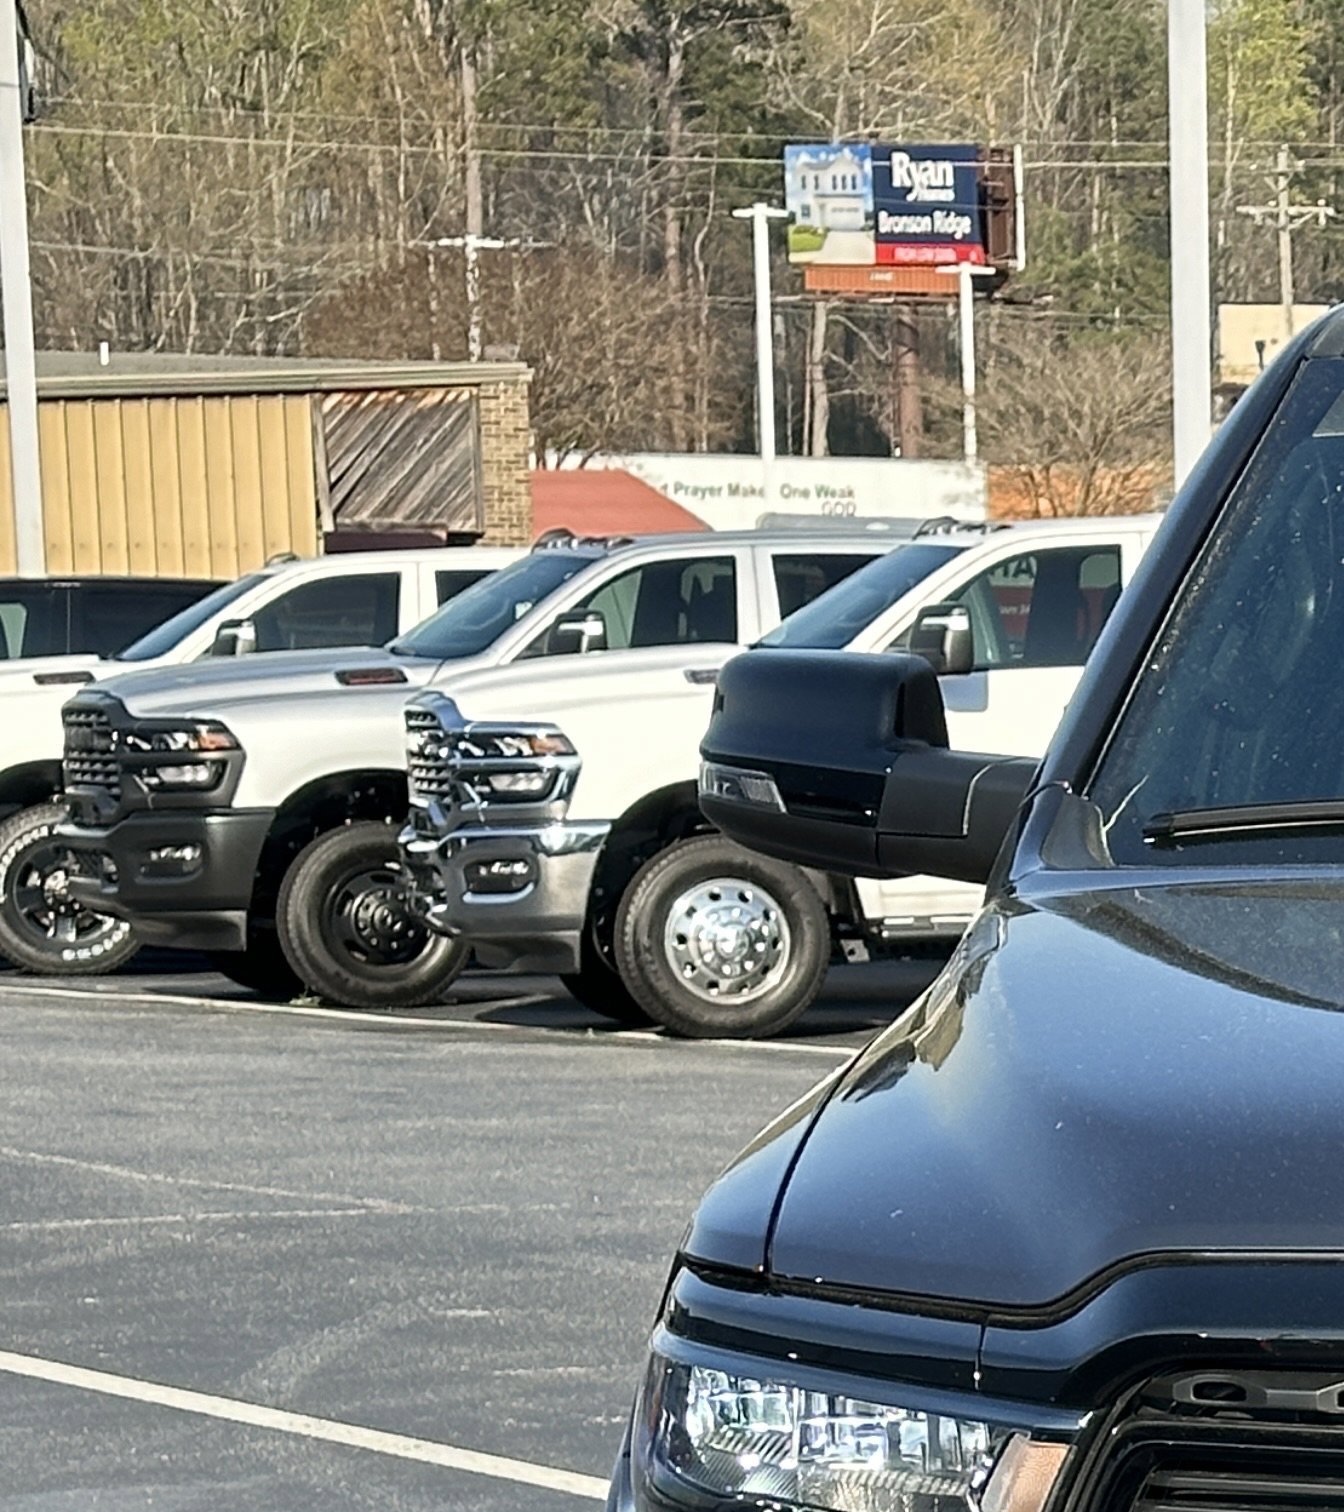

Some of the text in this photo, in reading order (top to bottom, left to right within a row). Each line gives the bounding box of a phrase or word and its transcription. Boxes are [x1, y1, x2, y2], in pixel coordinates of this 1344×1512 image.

[892, 152, 954, 201] Ryan
[878, 210, 971, 239] Bronson Ridge
[674, 482, 722, 500] Prayer
[780, 483, 810, 500] One
